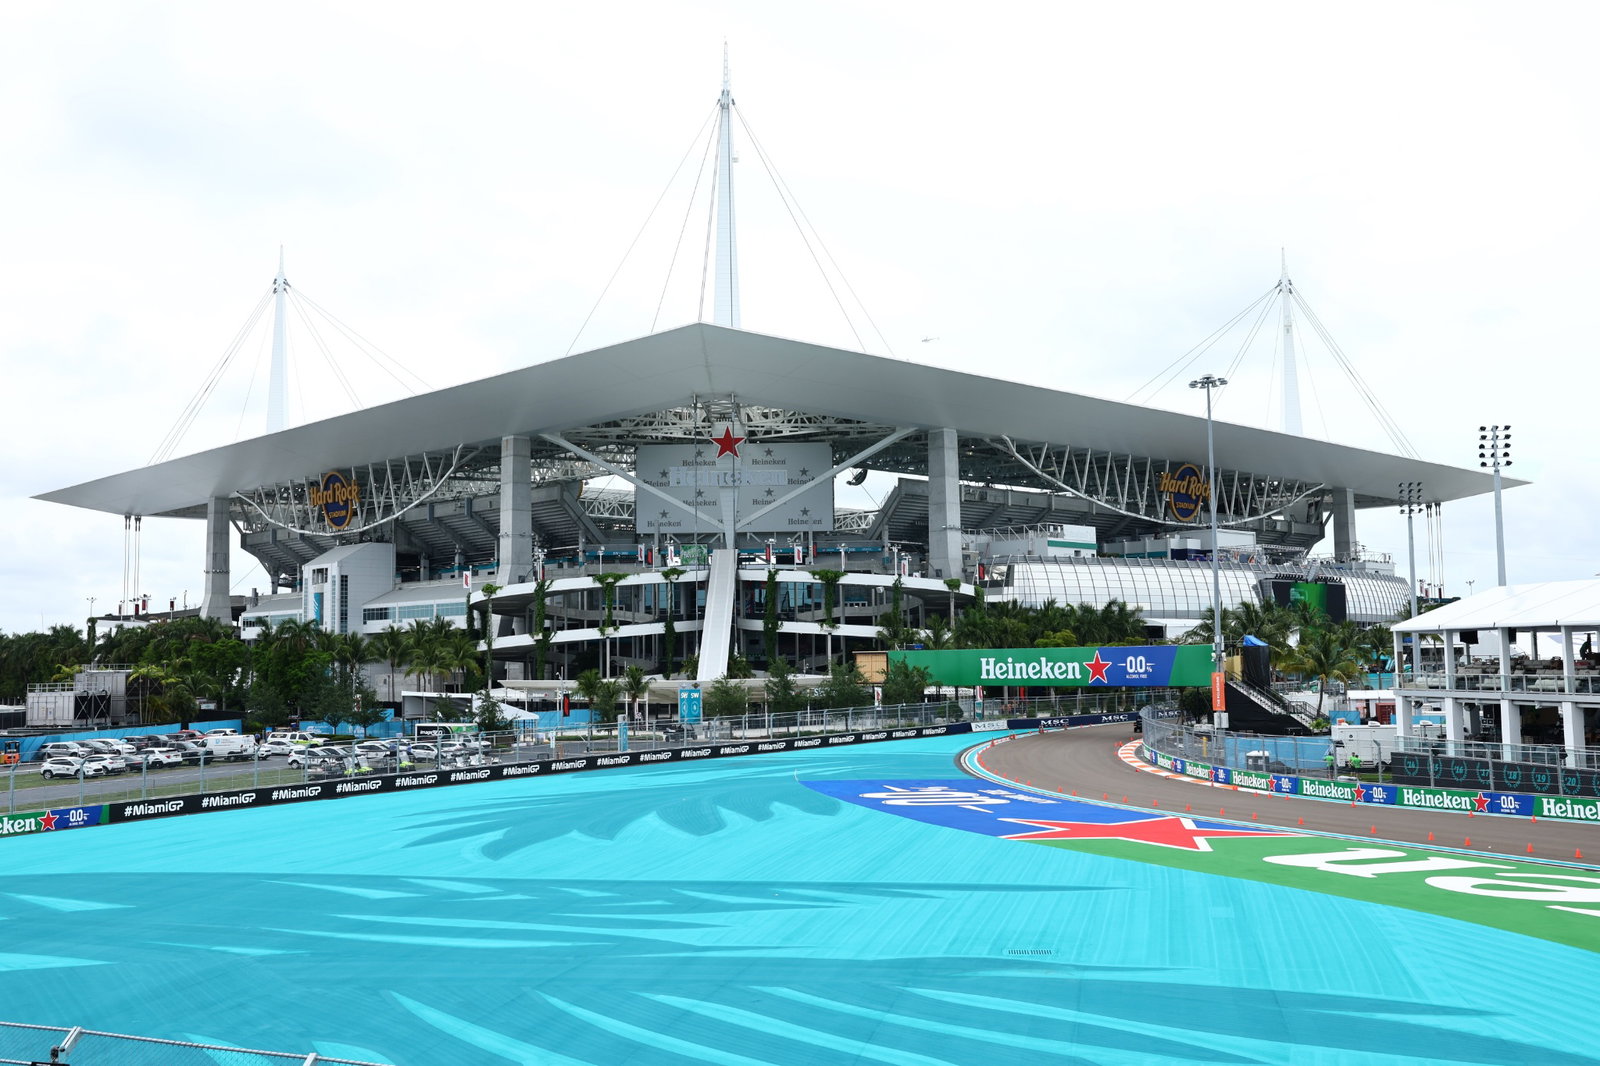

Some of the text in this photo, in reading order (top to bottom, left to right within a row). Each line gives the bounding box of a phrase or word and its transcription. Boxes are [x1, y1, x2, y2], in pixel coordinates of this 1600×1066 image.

[1160, 473, 1189, 494] Hard
[310, 479, 360, 506] Hard Rock
[1175, 502, 1196, 510] STADIUM
[328, 510, 347, 519] STADIUM
[980, 657, 1082, 679] Heineken
[975, 722, 1004, 730] MSC
[720, 745, 750, 754] #MiamiGP
[758, 742, 786, 751] #MiamiGP
[794, 739, 821, 747] #MiamiGP
[640, 752, 672, 762] #MiamiGP
[681, 748, 711, 758] #MiamiGP
[551, 760, 586, 770] #MiamiGP
[597, 755, 630, 766] #MiamiGP
[450, 769, 491, 781] #MiamiGP
[502, 764, 540, 776] #MiamiGP
[1186, 762, 1209, 779] Heineken
[395, 774, 438, 787] #MiamiGP
[1232, 770, 1267, 789] Heineken
[272, 786, 321, 800] #MiamiGP
[336, 780, 382, 793] #MiamiGP
[1303, 780, 1352, 799] Heineken
[201, 793, 256, 808] #MiamiGP
[1403, 788, 1471, 810] Heineken
[124, 800, 184, 816] #MiamiGP
[1542, 798, 1600, 820] Heine
